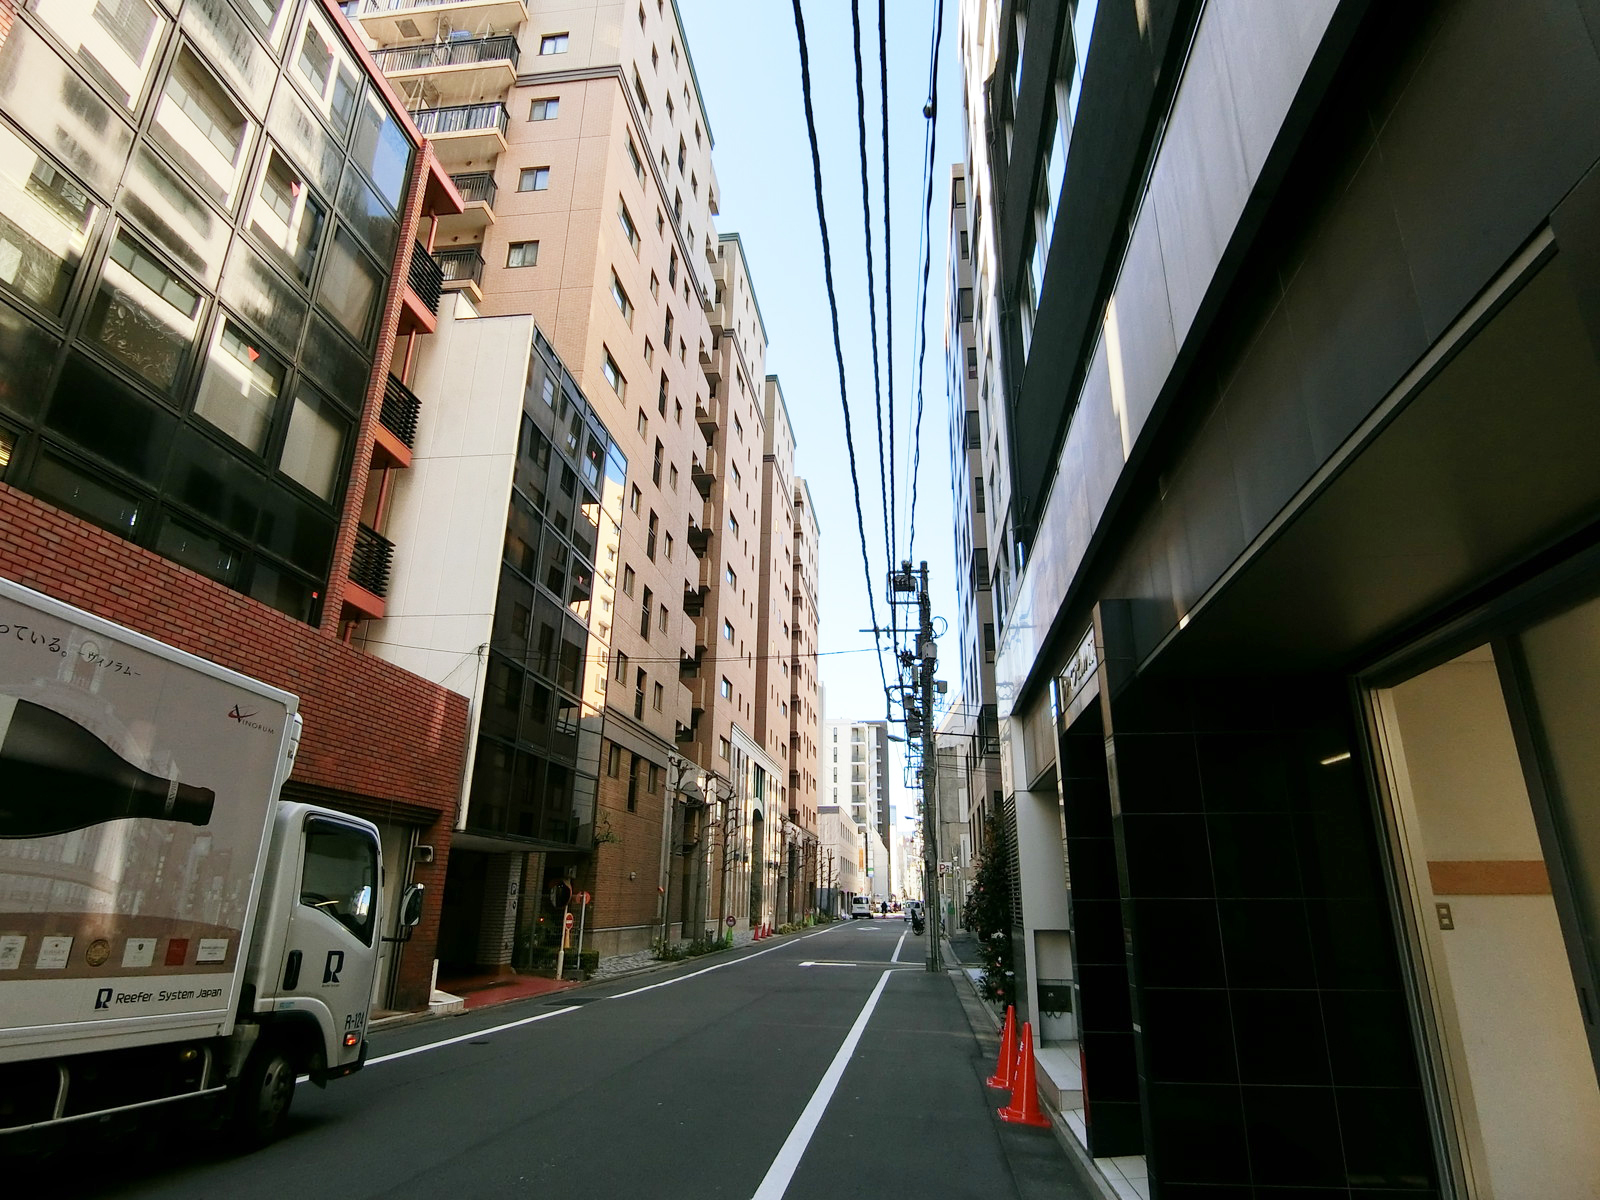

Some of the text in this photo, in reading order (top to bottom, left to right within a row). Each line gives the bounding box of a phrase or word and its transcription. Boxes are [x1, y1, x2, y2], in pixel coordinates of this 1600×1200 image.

[116, 992, 154, 1004] Reefer
[158, 990, 194, 1002] System
[196, 988, 222, 999] Japan
[345, 1012, 365, 1031] R-124
